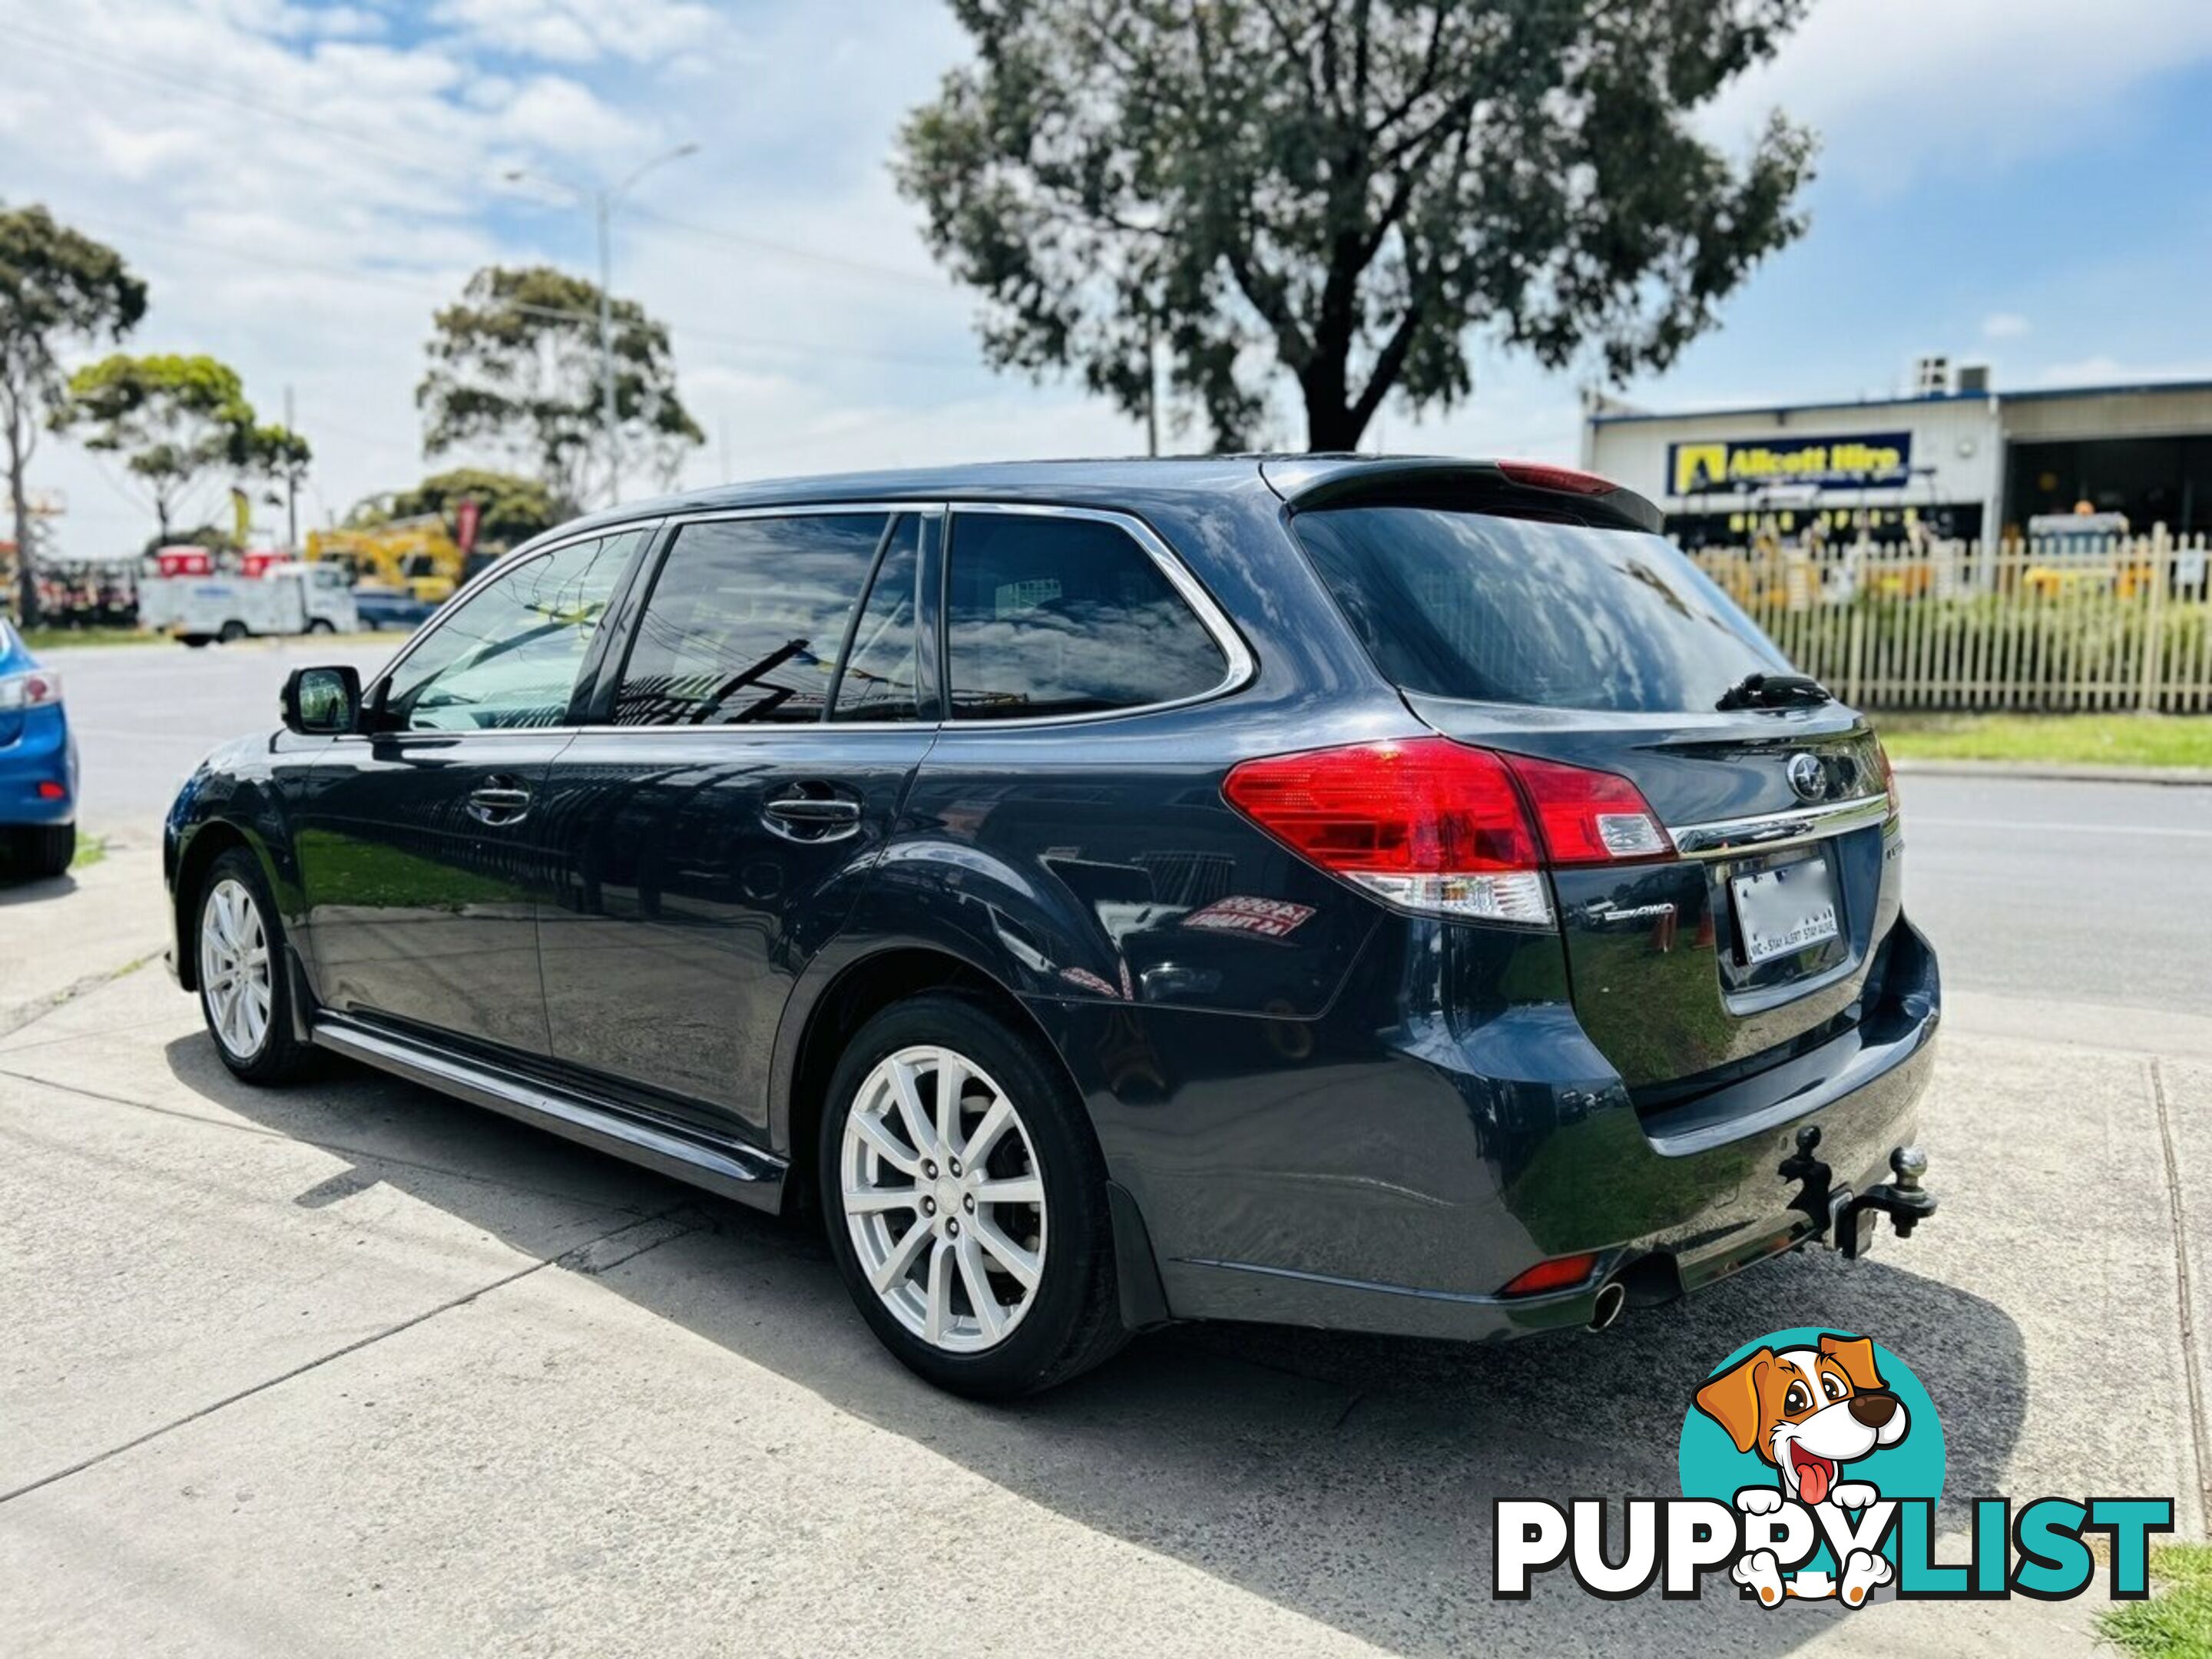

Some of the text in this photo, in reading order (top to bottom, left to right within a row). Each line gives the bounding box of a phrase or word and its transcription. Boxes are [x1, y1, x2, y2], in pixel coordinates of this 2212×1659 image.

[1830, 443, 1900, 472] Hire
[1634, 903, 1674, 916] AWD
[1751, 942, 1763, 955] VIC
[1768, 939, 1783, 952] STAY
[1785, 930, 1801, 945] ALERT
[1803, 926, 1817, 939] STAY
[1818, 920, 1834, 934] ALIVE
